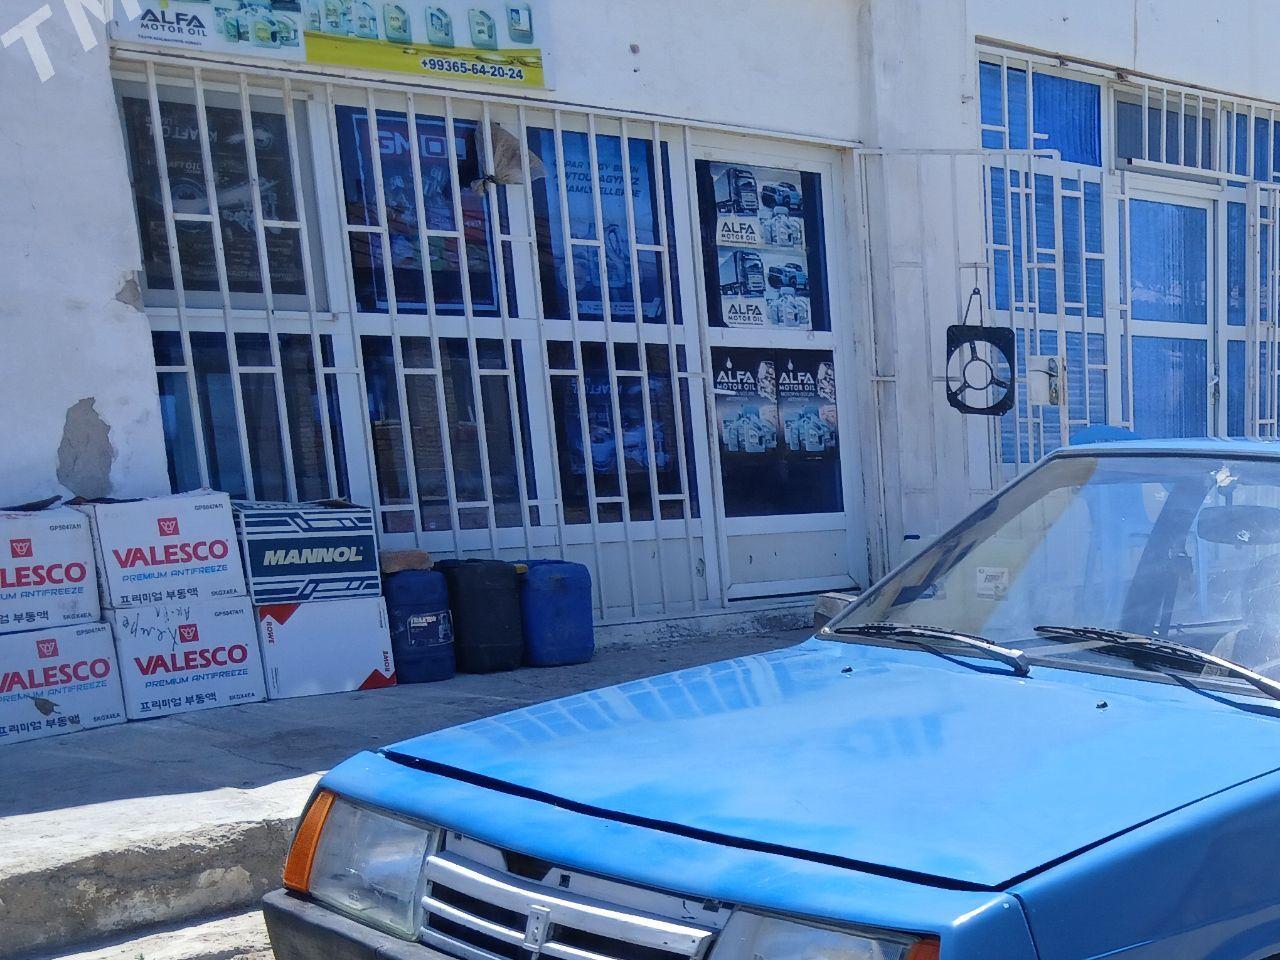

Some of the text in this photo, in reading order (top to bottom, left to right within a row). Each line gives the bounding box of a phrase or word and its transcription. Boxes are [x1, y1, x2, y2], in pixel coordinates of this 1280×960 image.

[140, 8, 206, 29] ALFA
[140, 22, 208, 37] MOTOR OIL
[421, 57, 524, 80] +99365-64-20-24
[721, 222, 756, 235] ALFA
[746, 234, 757, 242] OIL
[728, 304, 763, 316] ALFA
[716, 371, 755, 383] ALFA
[779, 372, 815, 384] ALFA
[744, 383, 756, 391] OIL
[112, 539, 229, 569] VALESCO
[263, 546, 363, 566] MANNOL
[122, 564, 229, 583] PREMIUM ANTIFREEZE
[20, 586, 85, 599] ANTIFREEZE
[120, 587, 199, 606] 프리미엄 부동액
[13, 610, 49, 623] 부동액
[266, 621, 275, 645] ROWE
[133, 644, 248, 676] VALESCO
[382, 650, 391, 672] ROWE
[47, 679, 108, 696] ANTIFREEZE
[145, 668, 249, 689] PREMIUM ANTIFREEZE
[140, 692, 217, 712] 프리미엄 부동액
[46, 713, 81, 729] 부동액
